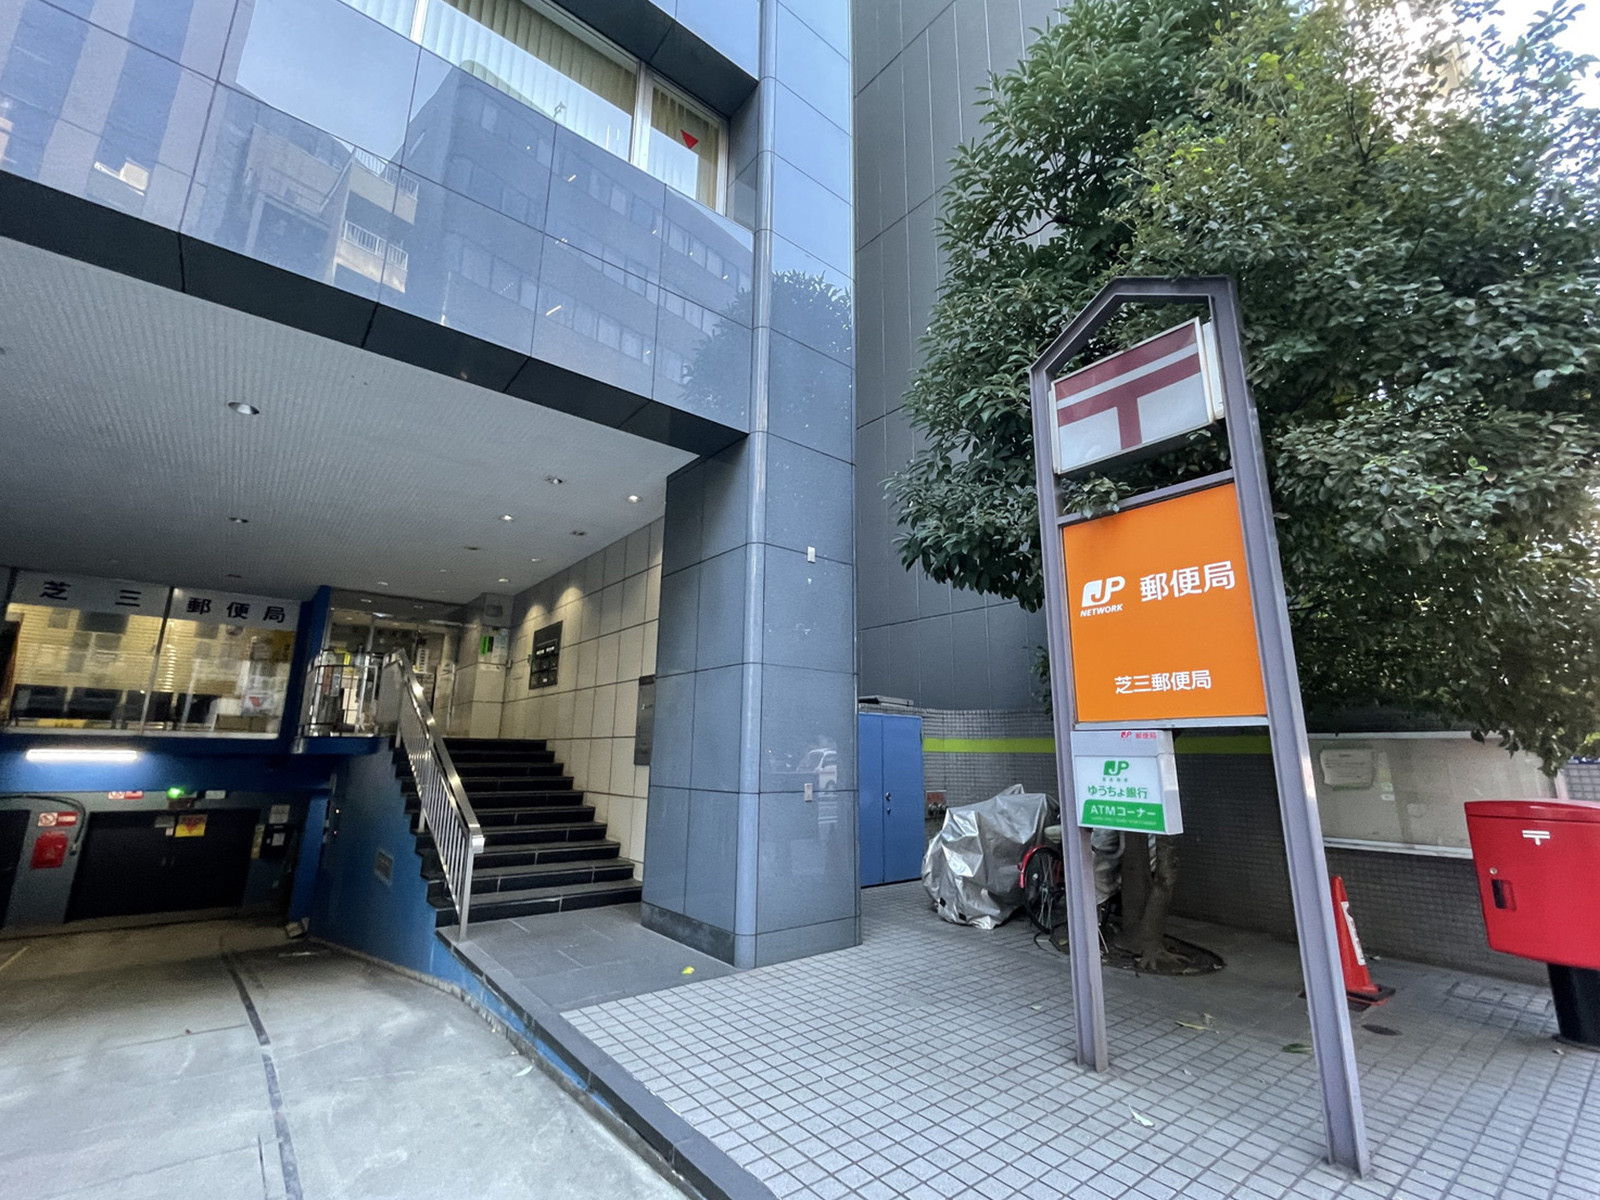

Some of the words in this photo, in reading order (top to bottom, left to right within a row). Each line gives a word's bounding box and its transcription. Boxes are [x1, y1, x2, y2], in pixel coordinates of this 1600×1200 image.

[1081, 576, 1126, 608] JP
[1139, 560, 1236, 602] 郵便局
[40, 580, 287, 624] 芝三郵便局
[1080, 603, 1124, 618] NETWORK
[1114, 669, 1212, 695] 芝三郵便局
[1103, 760, 1130, 776] JP
[1087, 785, 1148, 800] ゆうちょ銀行
[1090, 804, 1157, 819] ATMコーナー
